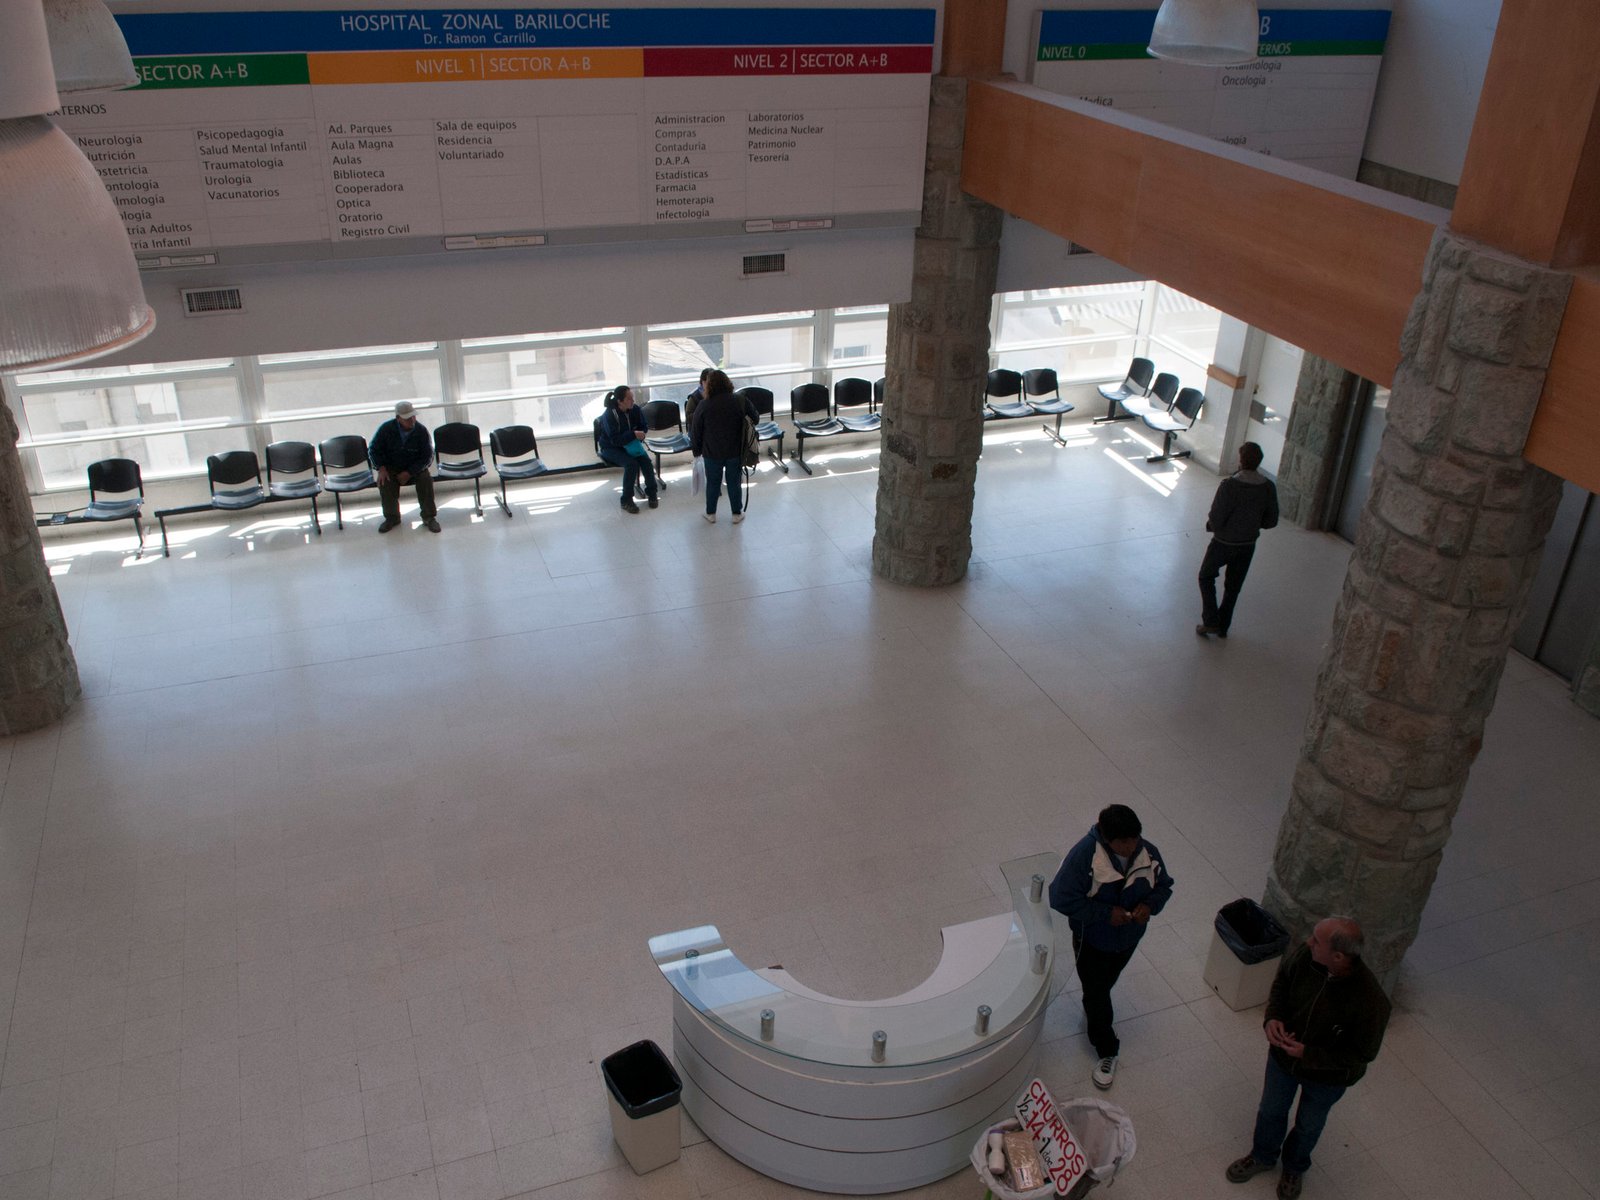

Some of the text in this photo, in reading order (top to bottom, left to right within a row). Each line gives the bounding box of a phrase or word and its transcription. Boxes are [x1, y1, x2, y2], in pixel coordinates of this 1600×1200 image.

[341, 13, 611, 32] HOSPITAL ZONAL BARILOCHE
[424, 32, 536, 44] Dr. Ramon Carrillo
[1042, 46, 1074, 58] NIVEL
[416, 57, 592, 73] NIVEL 1 SECTOR A+B
[734, 53, 888, 68] NIVEL 2 SECTOR A+B
[210, 63, 249, 80] A+B
[47, 104, 107, 117] TERNOS
[655, 114, 725, 124] Administracion
[748, 113, 804, 122] Laboratorios
[328, 124, 393, 135] Ad. Parques
[436, 120, 517, 131] Sala de equipos
[748, 125, 824, 135] Medicina Nuclear
[197, 127, 284, 141] Psicopedagogía
[655, 129, 697, 139] Compras
[78, 133, 143, 148] Neurología
[331, 140, 394, 151] Aula Magna
[438, 135, 493, 146] Residencia
[748, 140, 796, 149] Patrimonio
[199, 141, 308, 156] Salud Mental Infantil
[439, 149, 504, 160] Voluntariado
[203, 158, 284, 170] Traumatología
[332, 156, 362, 165] Aulas
[205, 174, 253, 186] Urología
[333, 170, 385, 180] Biblioteca
[335, 182, 404, 194] Cooperadora
[656, 183, 696, 193] Farmacia
[208, 188, 280, 201] Vacunatorios
[336, 198, 371, 210] Optica
[656, 196, 714, 206] Hemoterapia
[339, 212, 383, 223] Oratorio
[150, 222, 193, 235] Adultos
[342, 224, 410, 239] Registro Civil
[152, 236, 192, 249] Infantil
[1026, 1109, 1045, 1141] 14
[1030, 1081, 1084, 1176] CHURROS
[1049, 1157, 1073, 1192] 28
